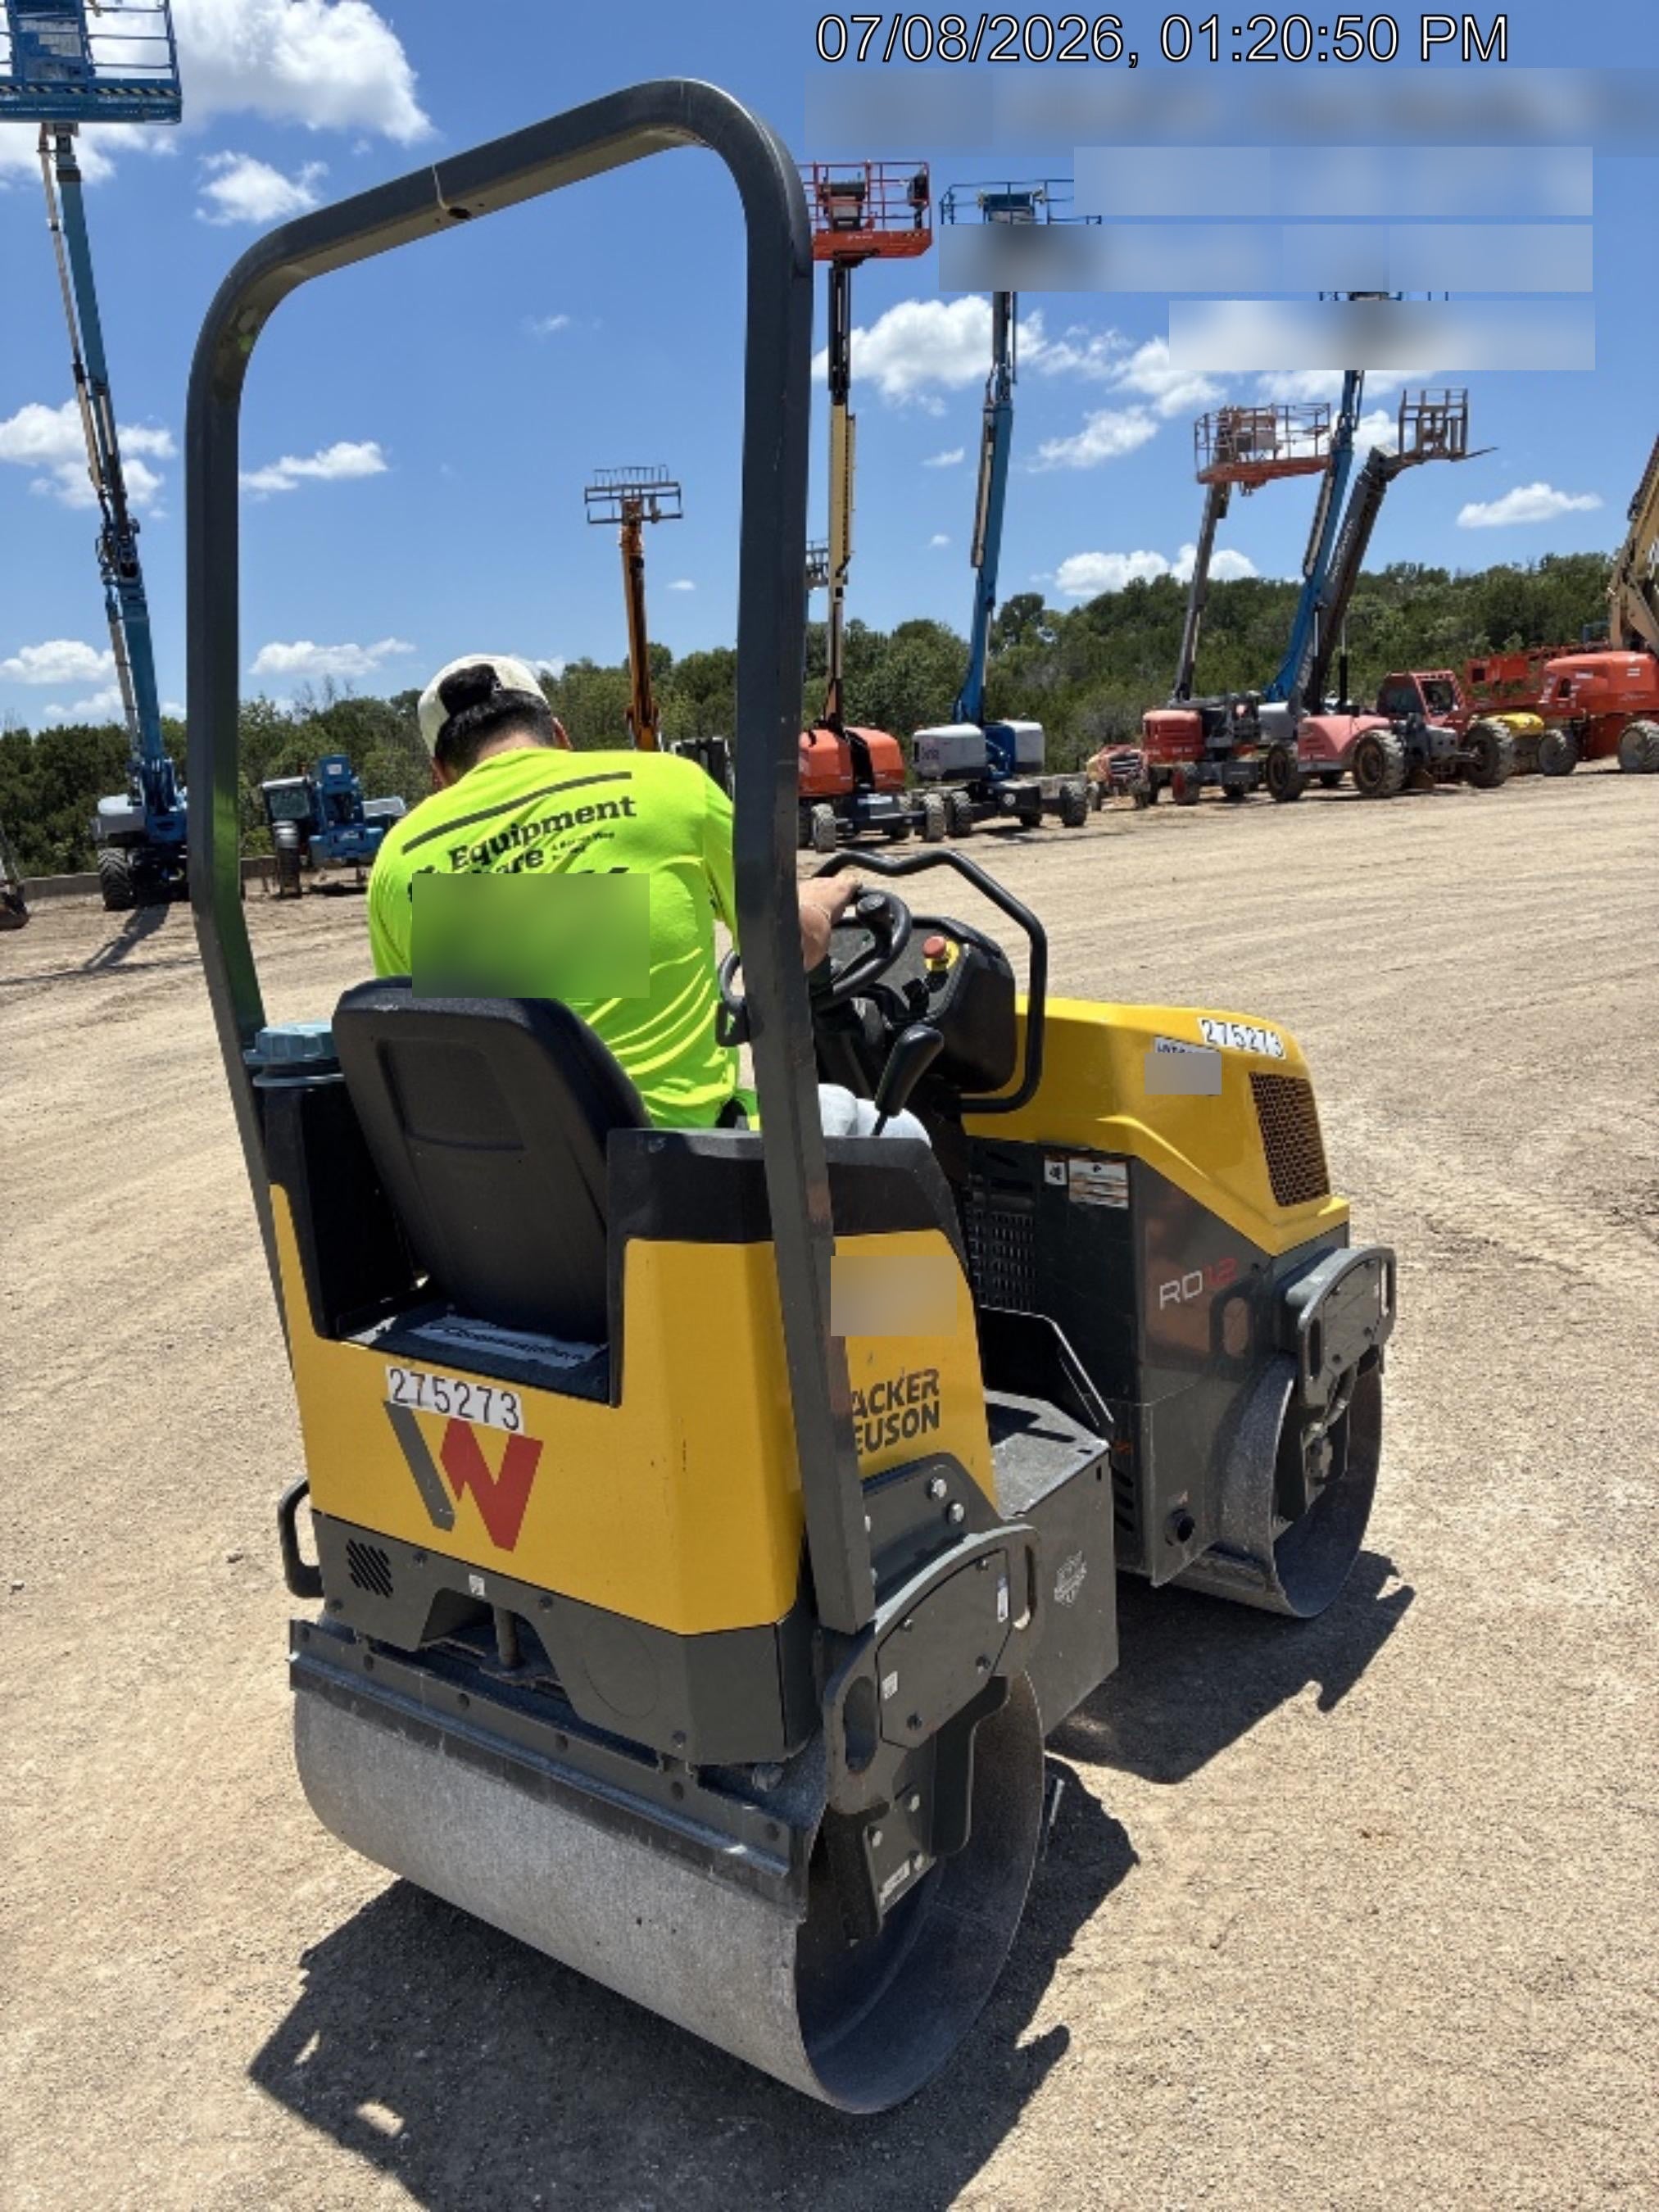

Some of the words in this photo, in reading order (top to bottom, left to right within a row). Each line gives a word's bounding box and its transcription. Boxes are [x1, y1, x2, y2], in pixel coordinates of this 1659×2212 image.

[448, 796, 637, 871] Equipment
[1201, 1019, 1285, 1058] 275273
[389, 1367, 520, 1432] 275273
[852, 1367, 941, 1418] ACKER
[855, 1400, 941, 1456] EUSON
